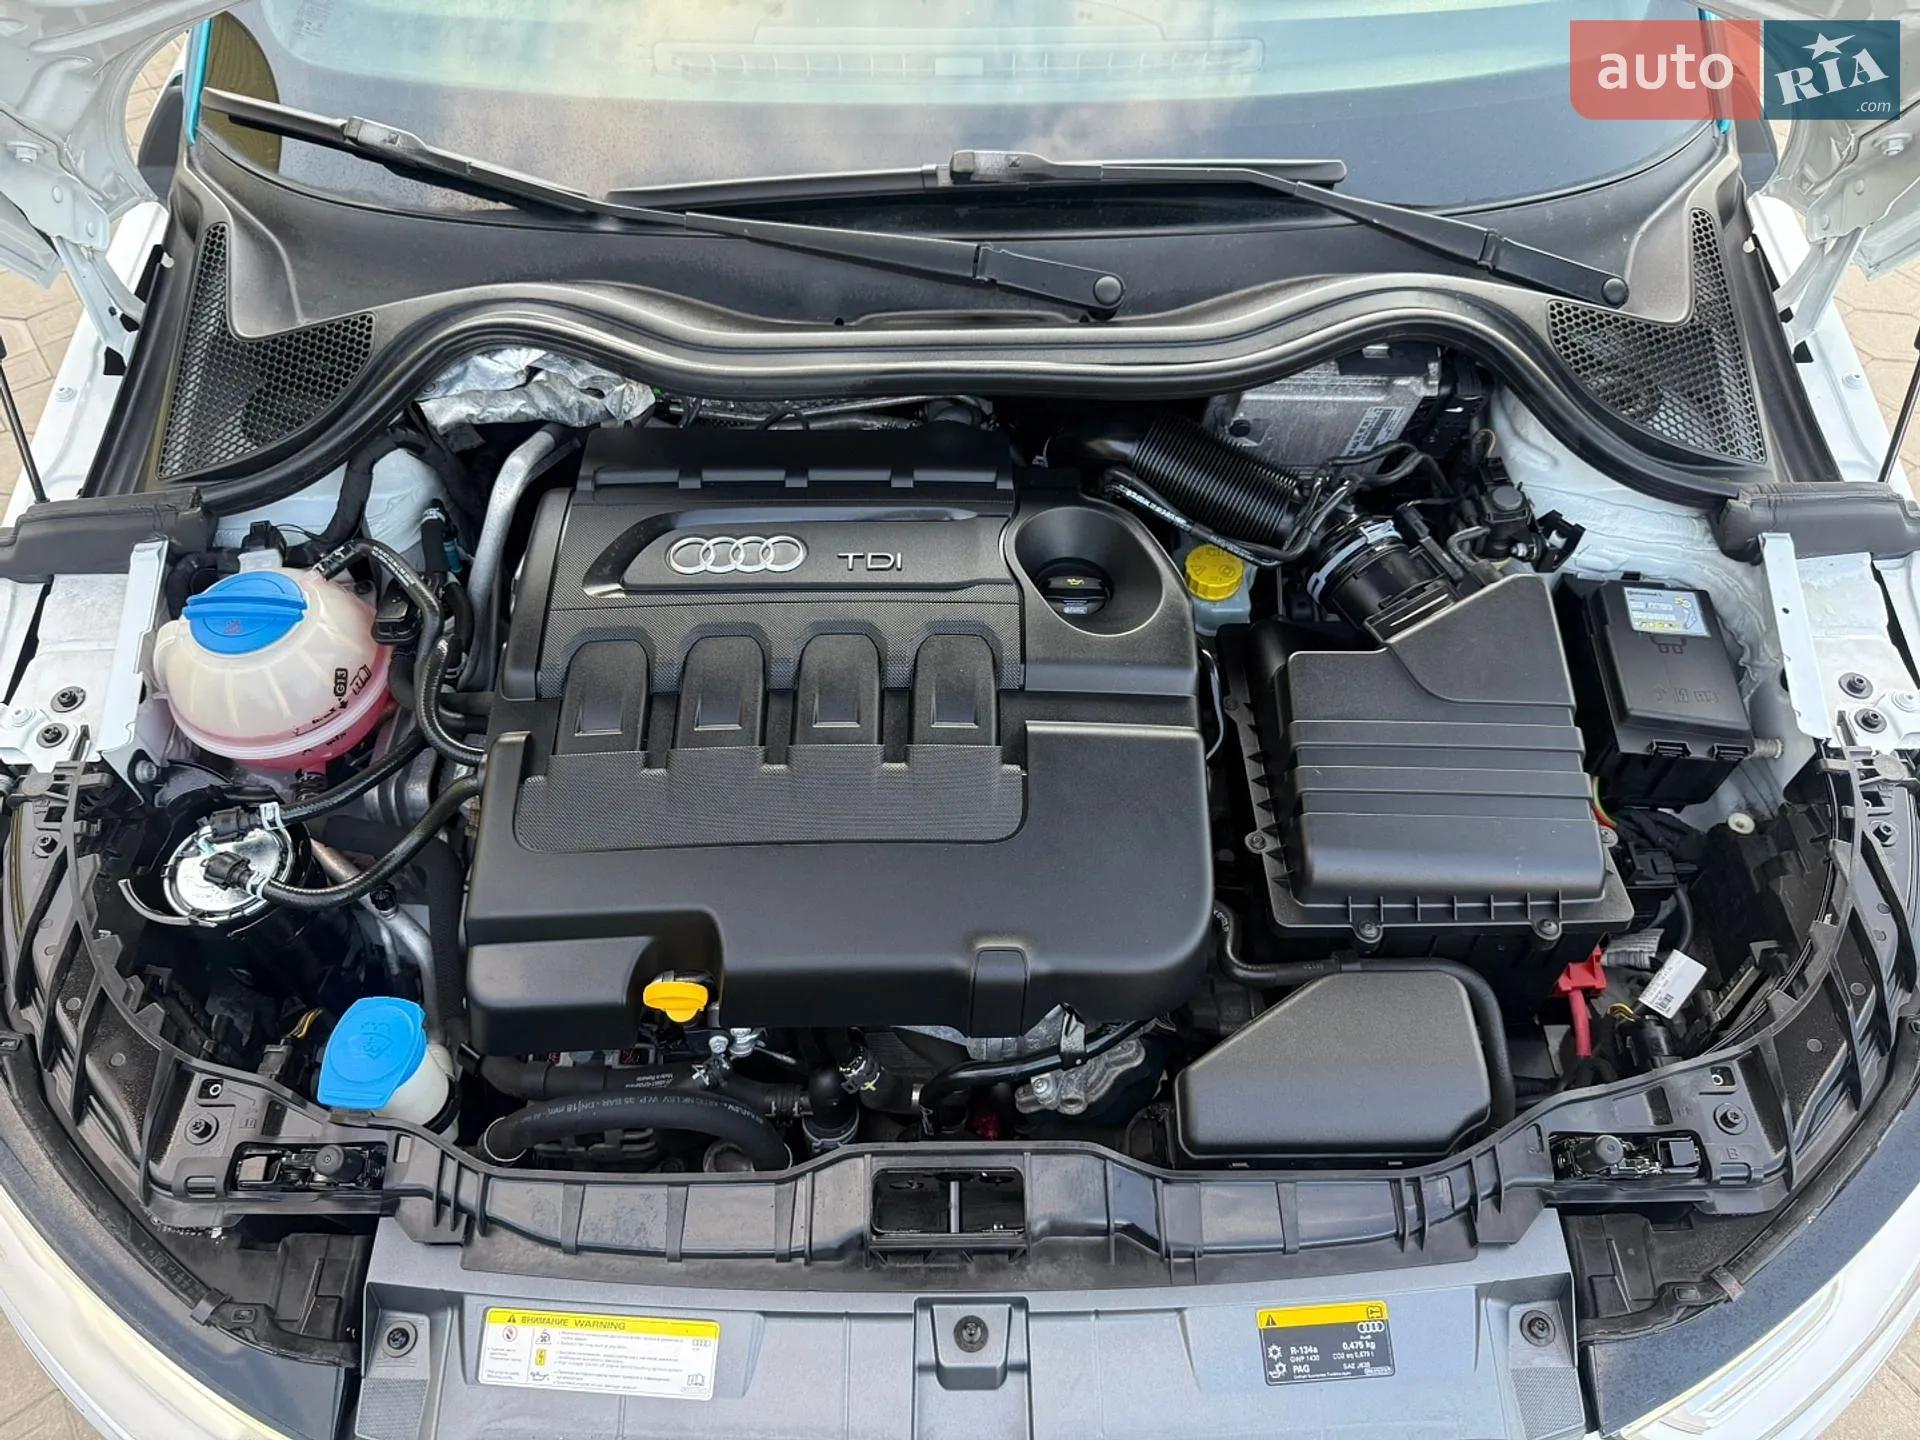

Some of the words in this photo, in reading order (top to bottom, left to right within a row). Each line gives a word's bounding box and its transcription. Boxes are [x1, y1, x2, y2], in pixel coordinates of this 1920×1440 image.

[837, 552, 902, 571] TDI
[574, 1319, 626, 1331] WARNING
[1290, 1346, 1318, 1354] R-134a
[1292, 1364, 1310, 1374] PAG
